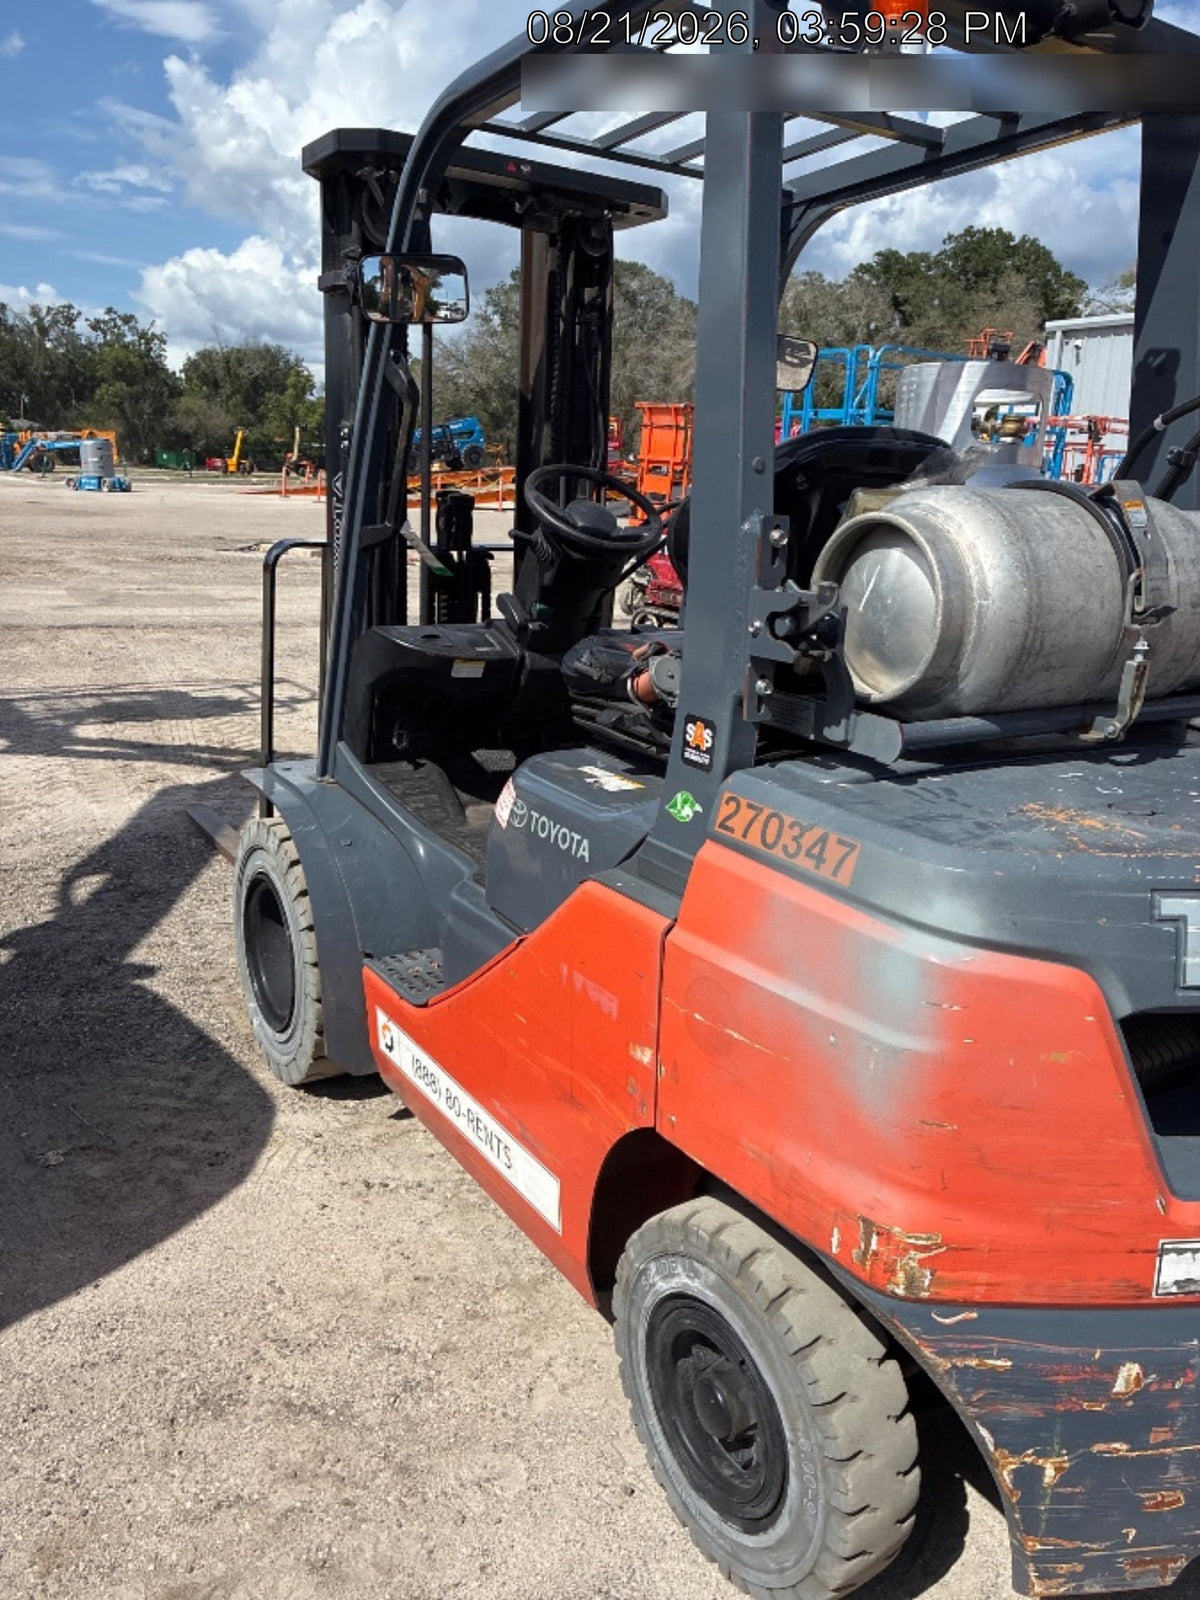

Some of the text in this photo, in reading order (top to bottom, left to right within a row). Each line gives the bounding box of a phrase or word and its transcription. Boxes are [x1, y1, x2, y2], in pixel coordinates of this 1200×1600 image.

[685, 721, 713, 751] SAS
[528, 809, 590, 863] TOYOTA
[717, 794, 859, 880] 270347
[411, 1053, 513, 1170] (888) 80-RENTS
